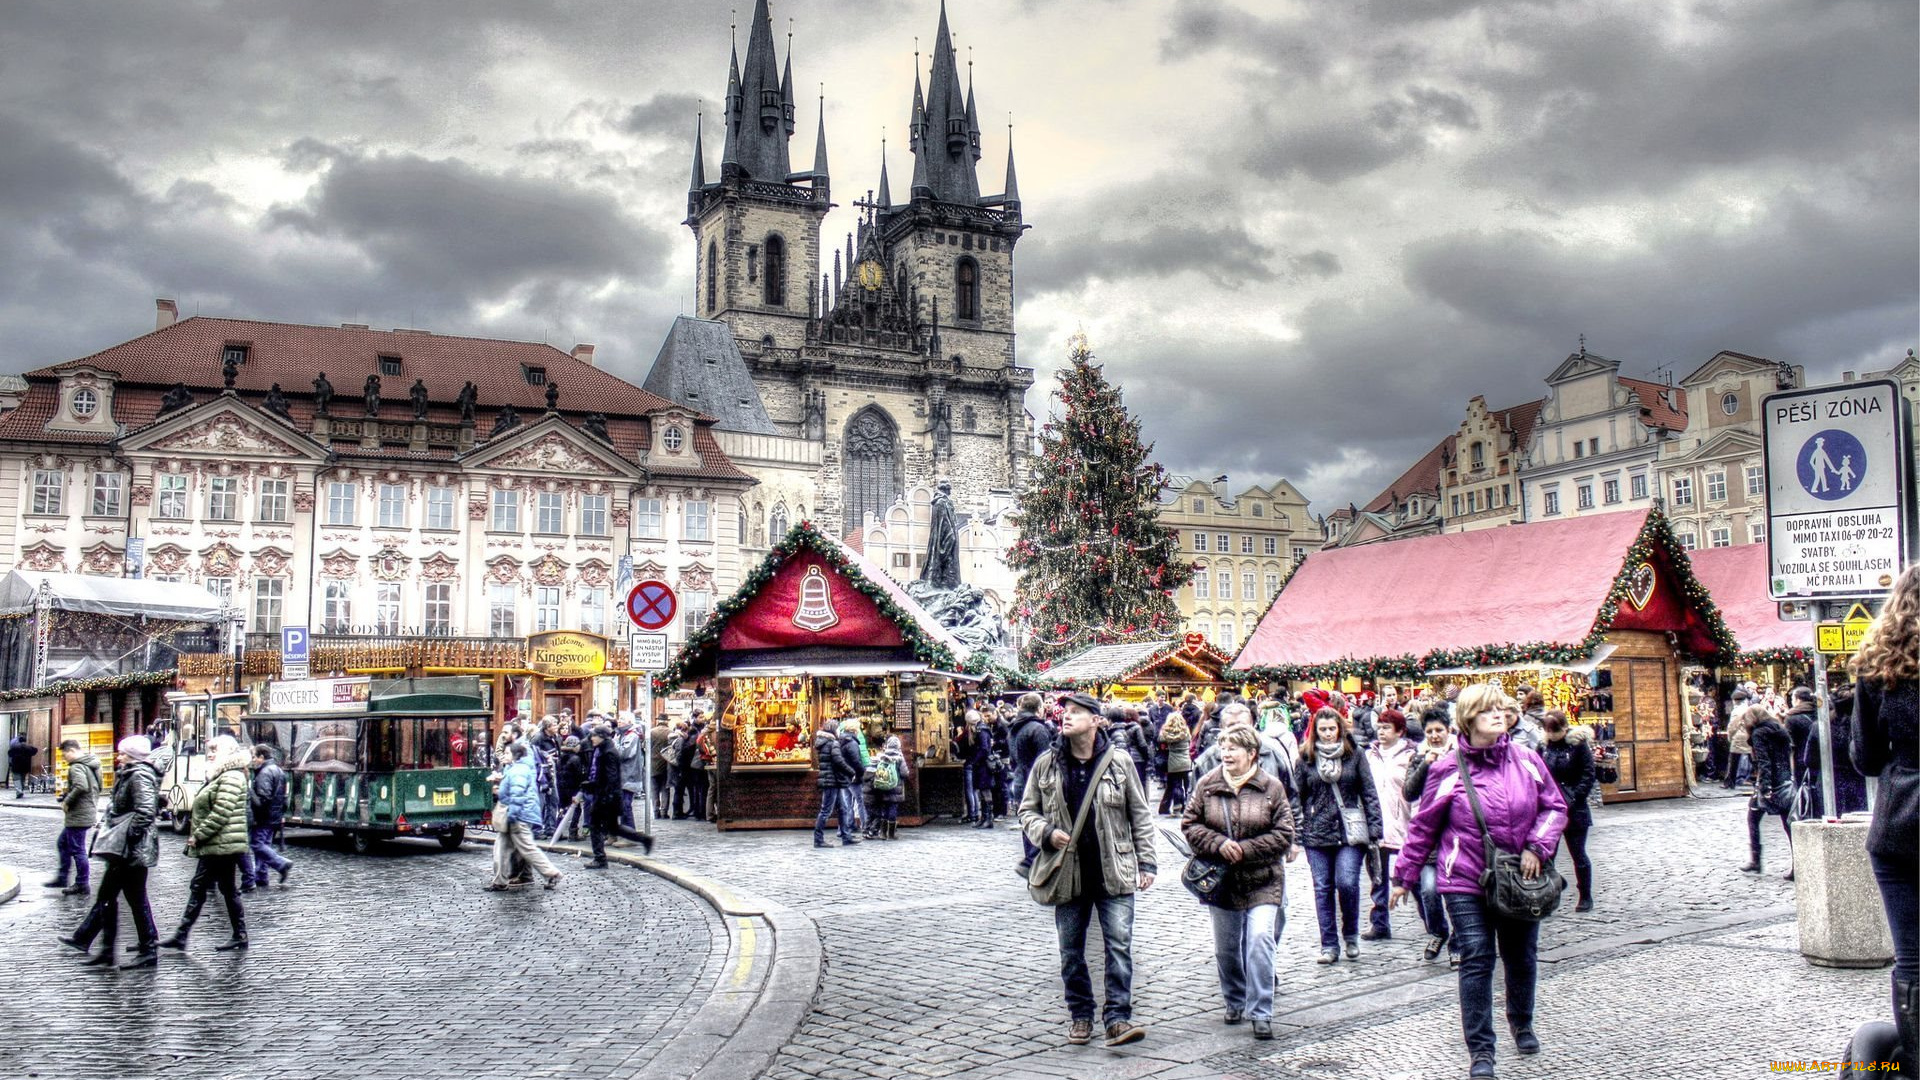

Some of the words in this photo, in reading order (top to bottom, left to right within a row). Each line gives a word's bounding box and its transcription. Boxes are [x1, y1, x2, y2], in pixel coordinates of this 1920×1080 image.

[1777, 401, 1817, 424] PĚŠÍ
[1828, 396, 1882, 418] ZÓNA
[1786, 515, 1832, 531] DOPRAVNÍ
[1837, 514, 1881, 527] OBSLUHA
[1793, 531, 1817, 544] MIMO
[1819, 530, 1840, 542] TAXI
[1841, 529, 1866, 541] 06-09
[1867, 528, 1893, 539] 20-22
[1780, 562, 1816, 575] VOZIDLA
[1818, 561, 1830, 573] SE
[1833, 558, 1892, 572] SOUHLASEM
[1807, 573, 1820, 587] MČ
[1822, 575, 1855, 586] PRAHA
[1858, 574, 1862, 584] 1
[288, 631, 303, 652] P
[551, 636, 585, 649] Welcome
[535, 649, 598, 667] Kingswood
[271, 690, 319, 705] CONCERTS
[334, 684, 351, 695] DAILY
